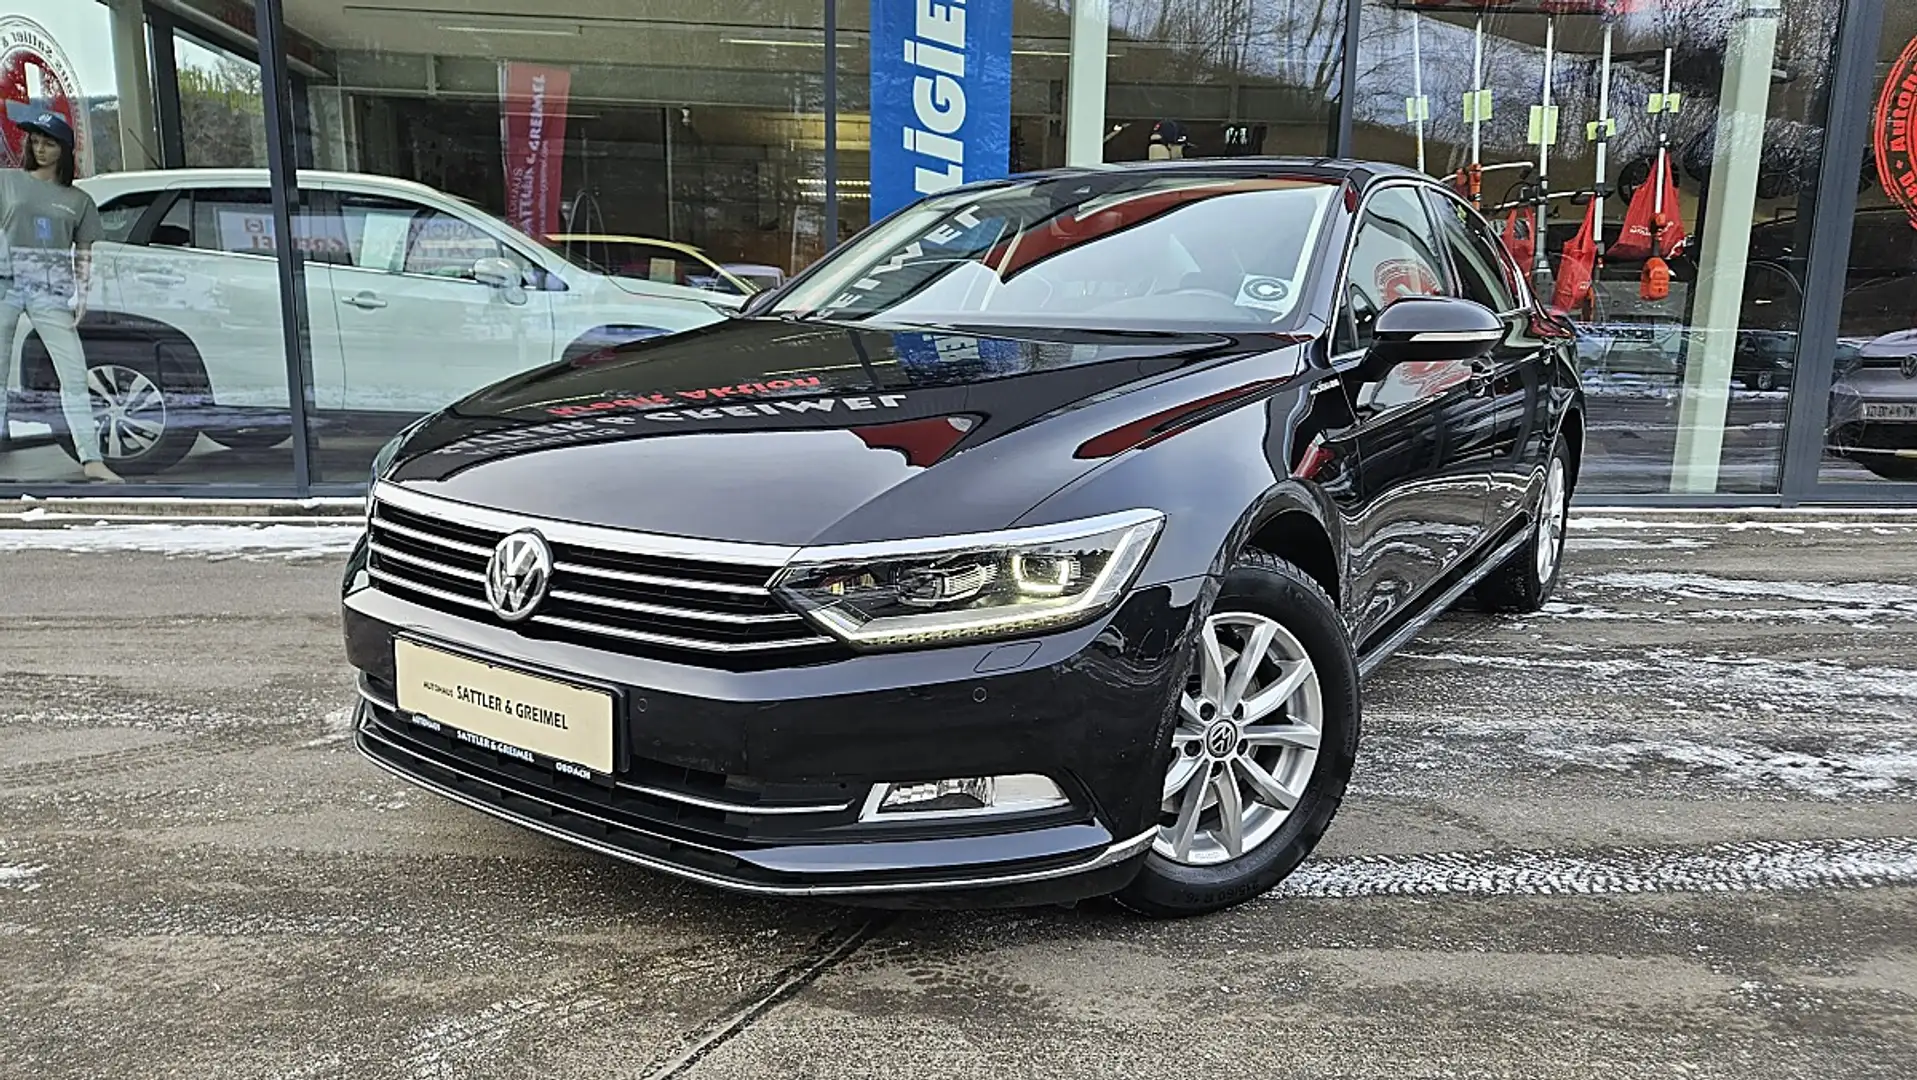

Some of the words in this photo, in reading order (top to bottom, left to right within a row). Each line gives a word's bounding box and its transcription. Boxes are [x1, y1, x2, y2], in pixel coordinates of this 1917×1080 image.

[528, 74, 546, 151] GREIMEL
[456, 685, 502, 712] SATTLER
[504, 699, 513, 715] &
[515, 702, 569, 730] GREIMEL
[456, 730, 490, 749] SATTLER
[497, 743, 535, 763] GREIMEL
